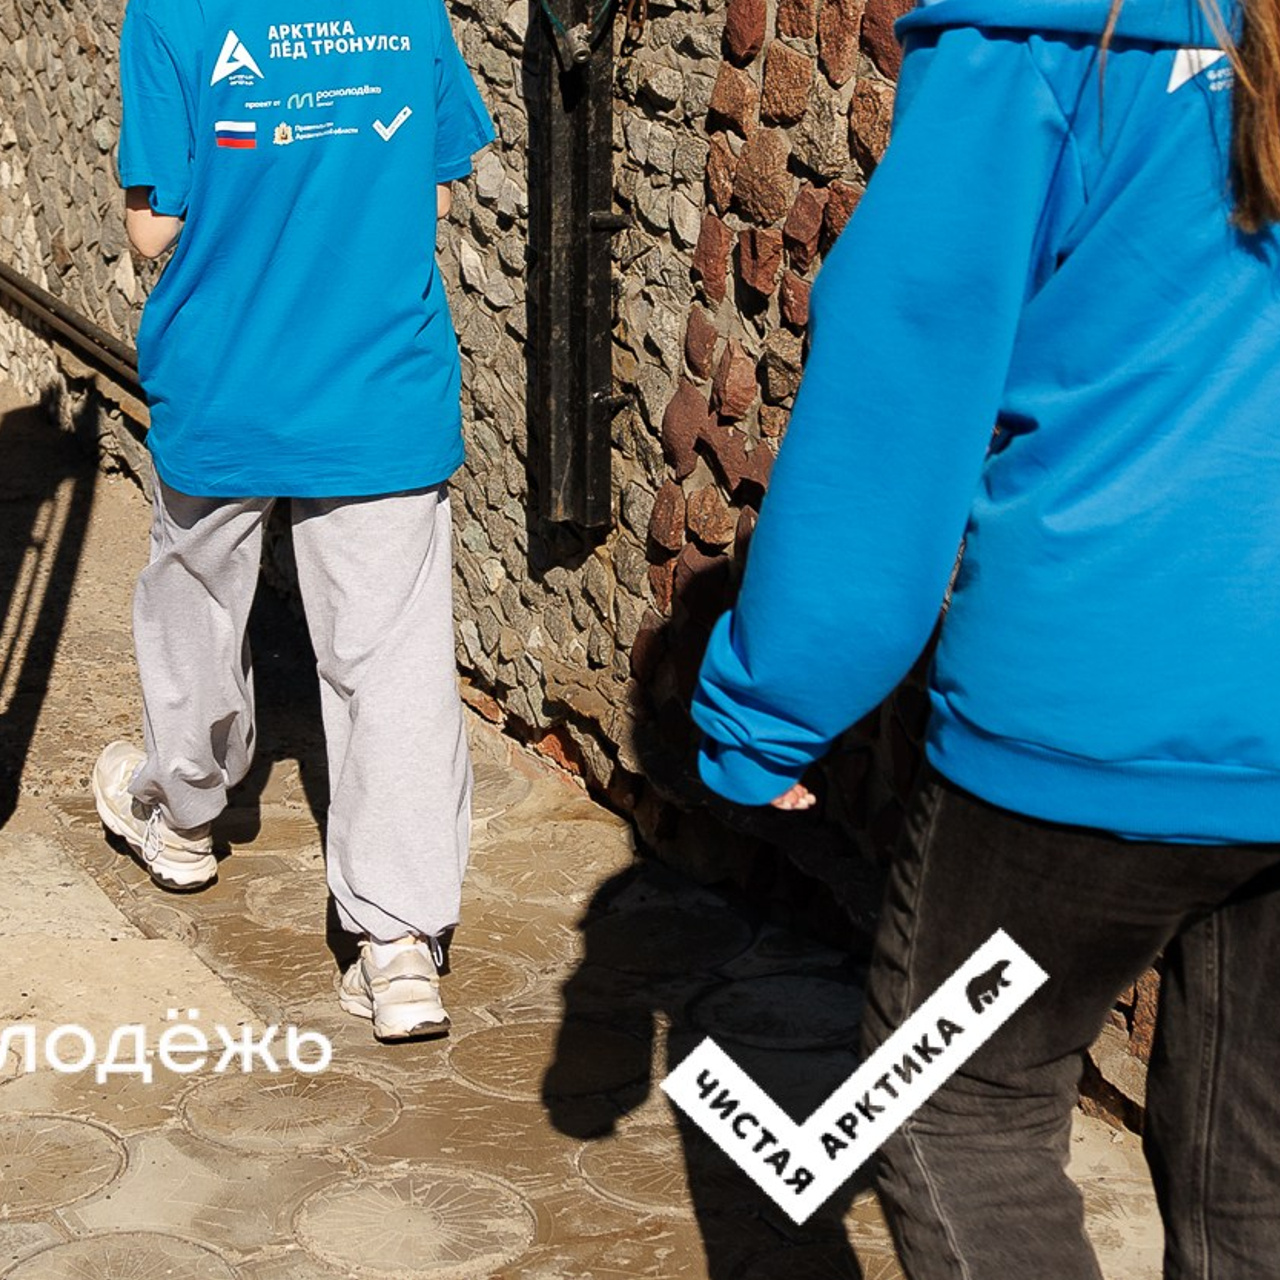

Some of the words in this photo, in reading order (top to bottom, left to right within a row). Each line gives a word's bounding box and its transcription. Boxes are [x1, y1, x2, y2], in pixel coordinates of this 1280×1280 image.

[268, 20, 355, 41] АРКТИКА
[269, 39, 308, 60] ЛЁД
[311, 35, 411, 56] ТРОНУЛСЯ
